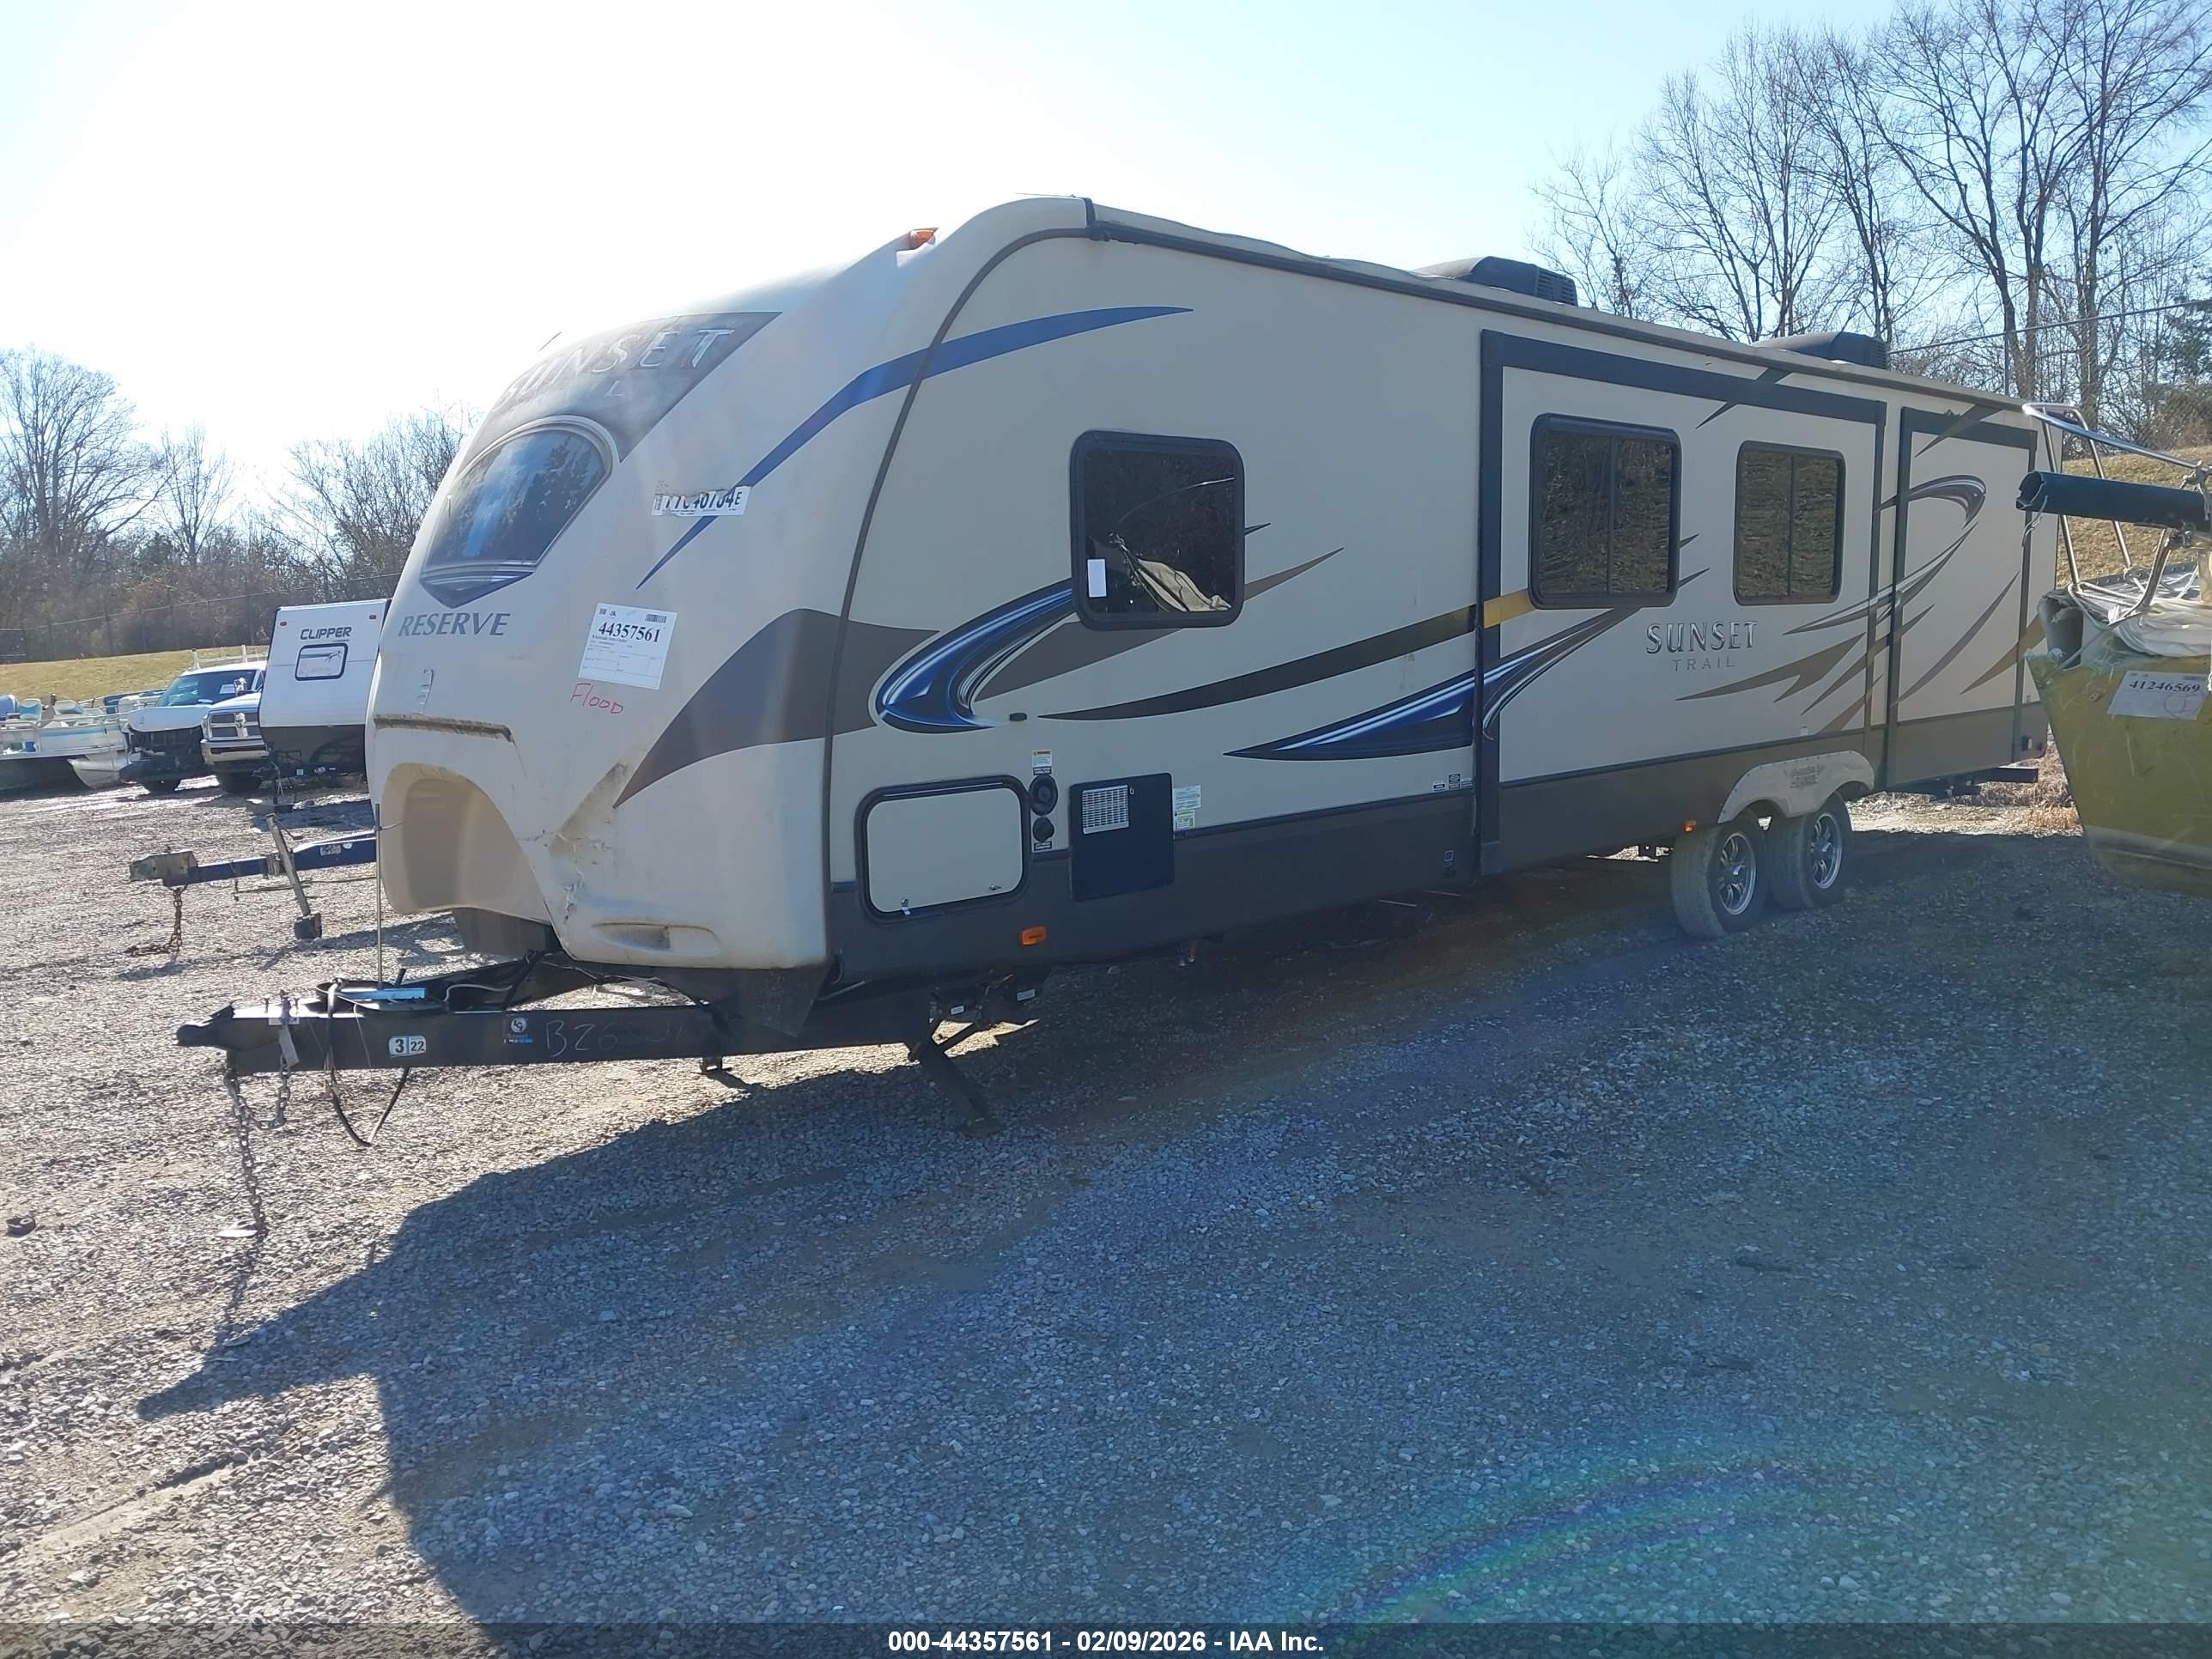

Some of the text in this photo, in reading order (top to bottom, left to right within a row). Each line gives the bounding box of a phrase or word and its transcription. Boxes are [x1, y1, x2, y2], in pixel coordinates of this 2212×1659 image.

[398, 612, 511, 637] RESERVE
[598, 621, 661, 643] 44357561
[300, 626, 352, 640] CLIPPER
[1646, 620, 1759, 654] SUNSET
[1672, 656, 1735, 672] TRAIL
[2129, 679, 2201, 693] 41246569
[394, 1038, 425, 1054] 3 22
